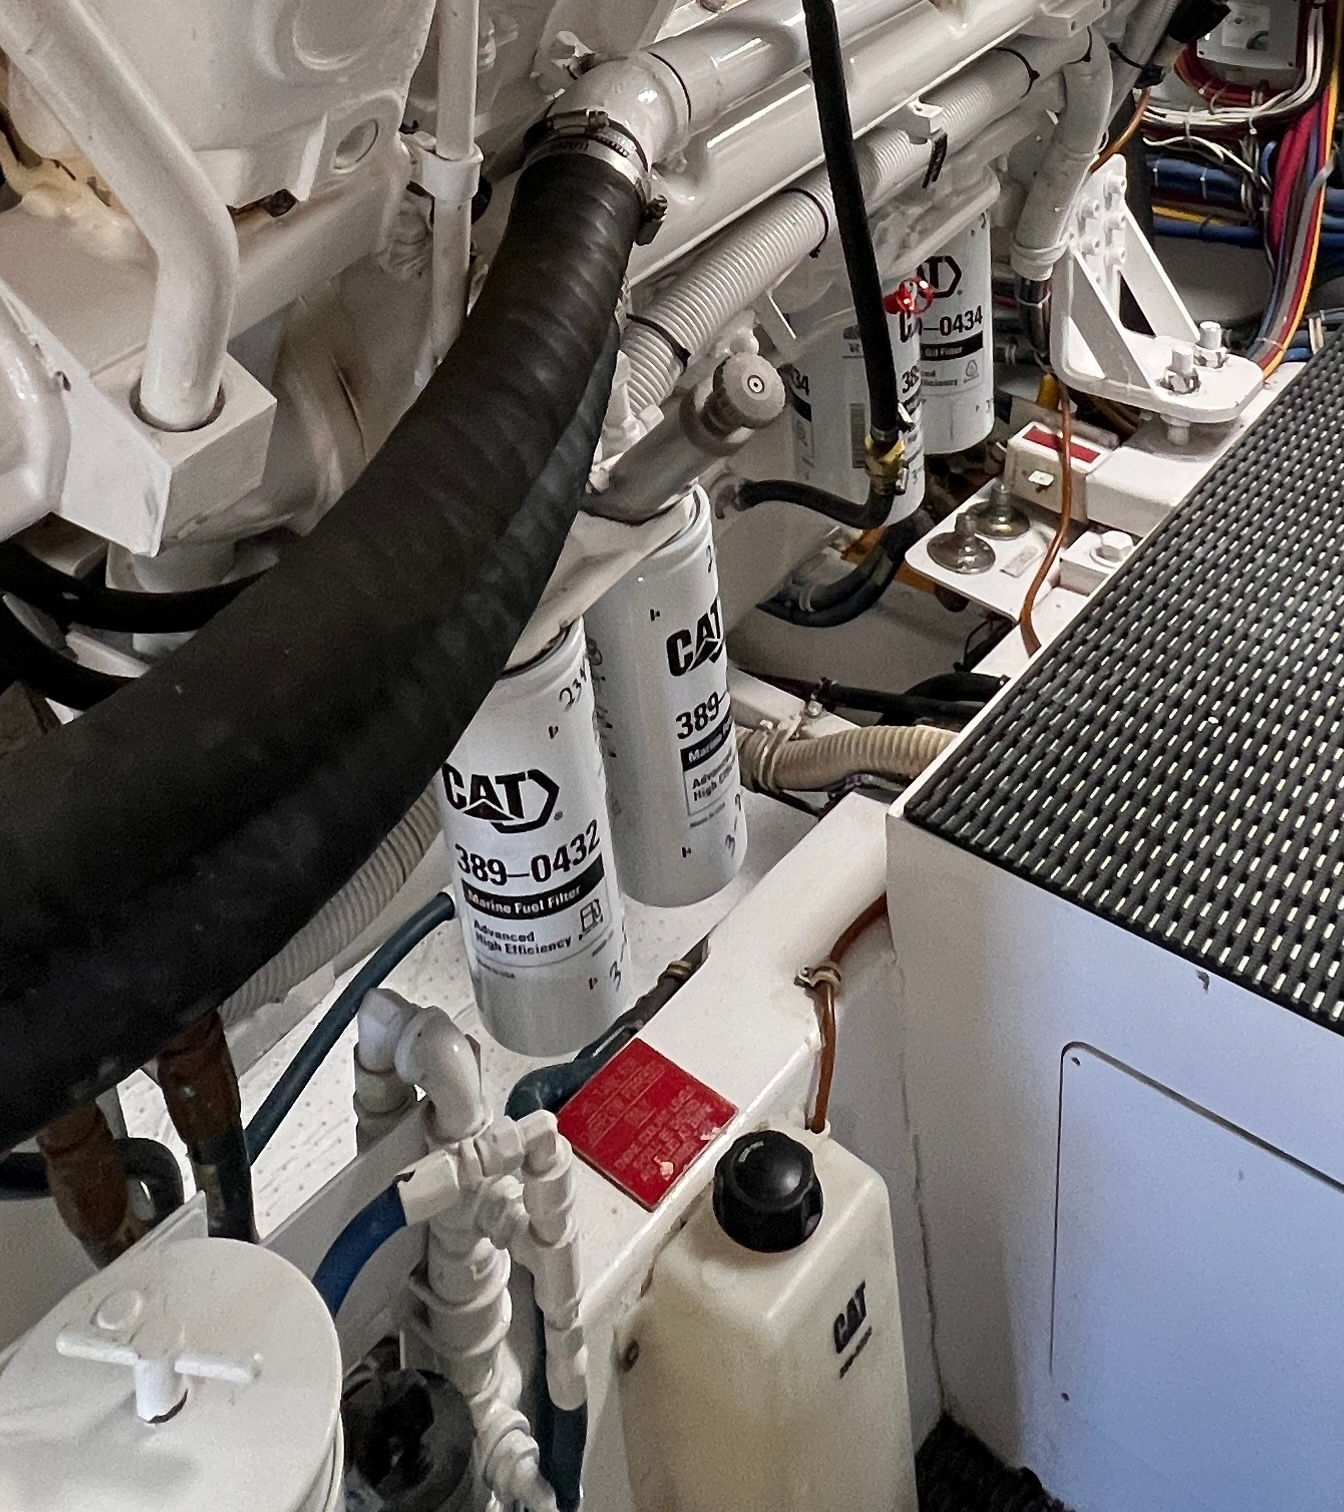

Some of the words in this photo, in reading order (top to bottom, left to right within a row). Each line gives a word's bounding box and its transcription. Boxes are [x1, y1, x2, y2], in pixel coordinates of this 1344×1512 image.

[441, 763, 527, 821] CAT
[455, 819, 601, 886] 389-0432
[467, 889, 512, 914] Marine
[514, 900, 545, 915] Fuel
[547, 885, 581, 908] Filter
[473, 919, 535, 942] Advanced
[475, 931, 502, 953] High
[505, 935, 572, 955] Efficiency
[834, 1280, 867, 1354] CAT
